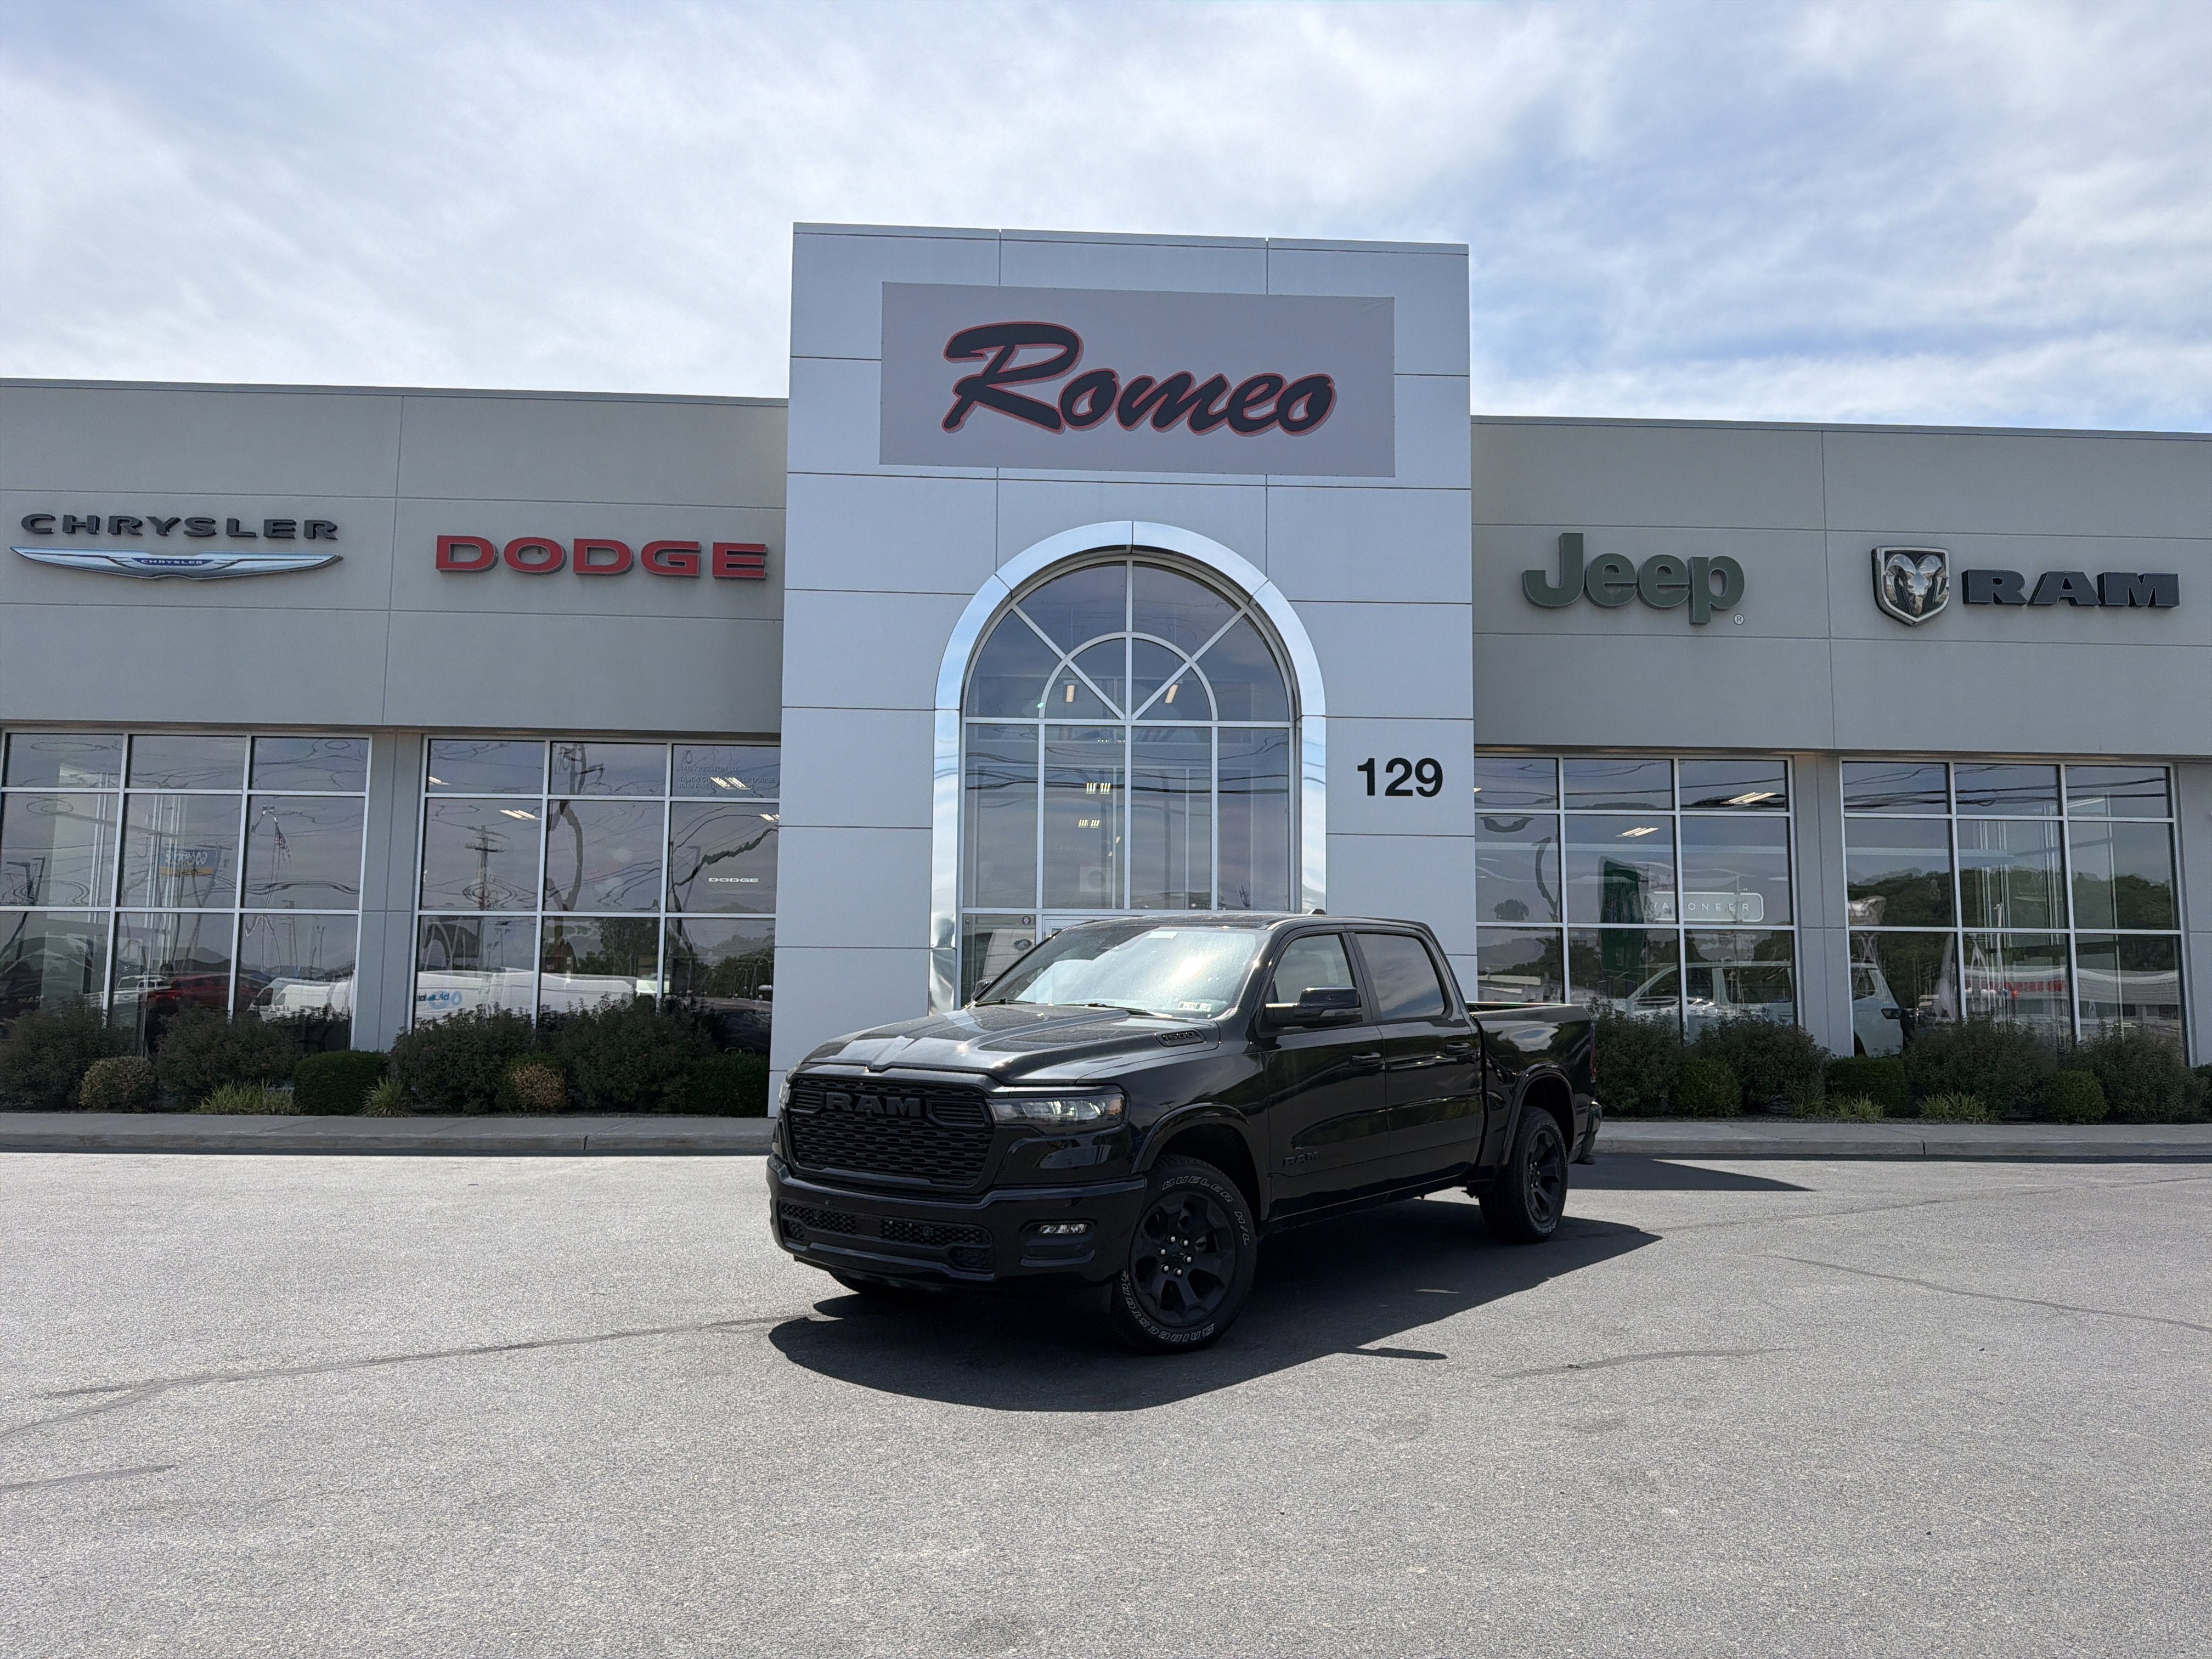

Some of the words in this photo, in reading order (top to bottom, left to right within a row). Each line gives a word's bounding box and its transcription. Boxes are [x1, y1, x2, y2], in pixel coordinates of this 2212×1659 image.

[941, 321, 1336, 436] Romeo
[21, 514, 338, 540] CHRYSLER
[436, 535, 767, 580] DODGE
[1522, 533, 1745, 625] Jeep
[1962, 569, 2179, 608] RAM
[1357, 758, 1443, 797] 129
[1654, 902, 1749, 911] AONEER
[1163, 1031, 1195, 1041] 1500
[826, 1091, 922, 1117] RAM
[1161, 1175, 1233, 1203] DUELER
[1234, 1210, 1250, 1246] H/L
[1120, 1270, 1215, 1342] BRIDGESTONE
